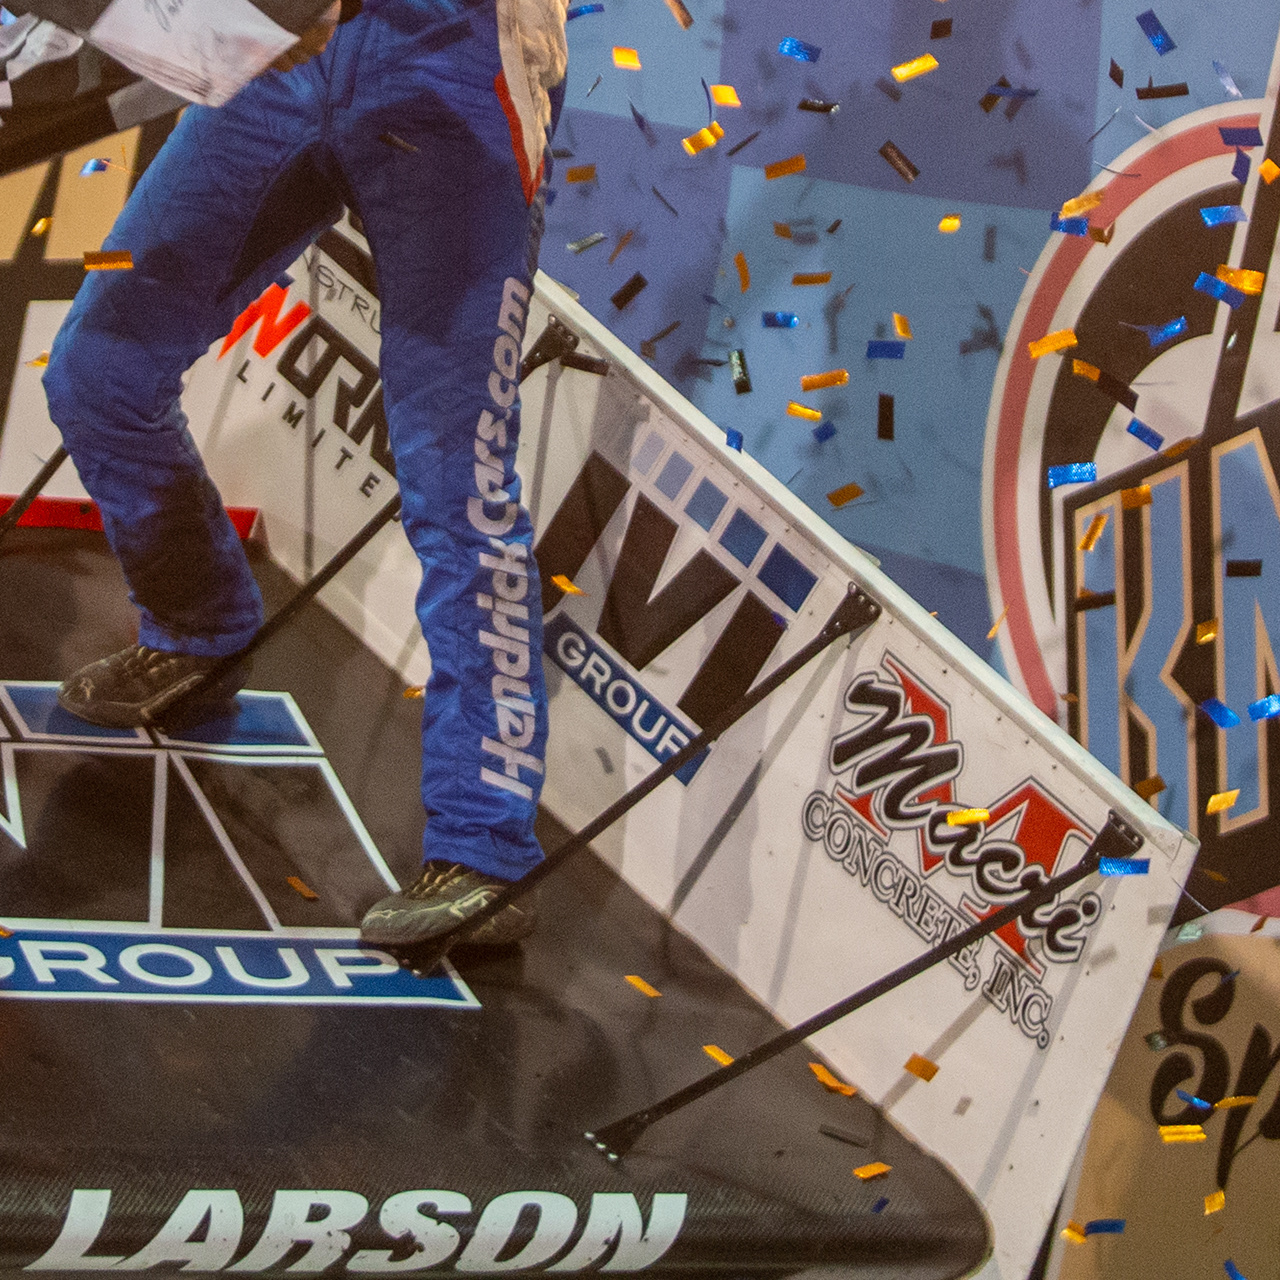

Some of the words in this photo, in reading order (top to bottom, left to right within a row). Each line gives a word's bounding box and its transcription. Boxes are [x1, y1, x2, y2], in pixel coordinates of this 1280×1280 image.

[467, 276, 548, 800] HendrickCars.com
[981, 950, 1054, 1050] INC.
[22, 1187, 689, 1273] LARSON
